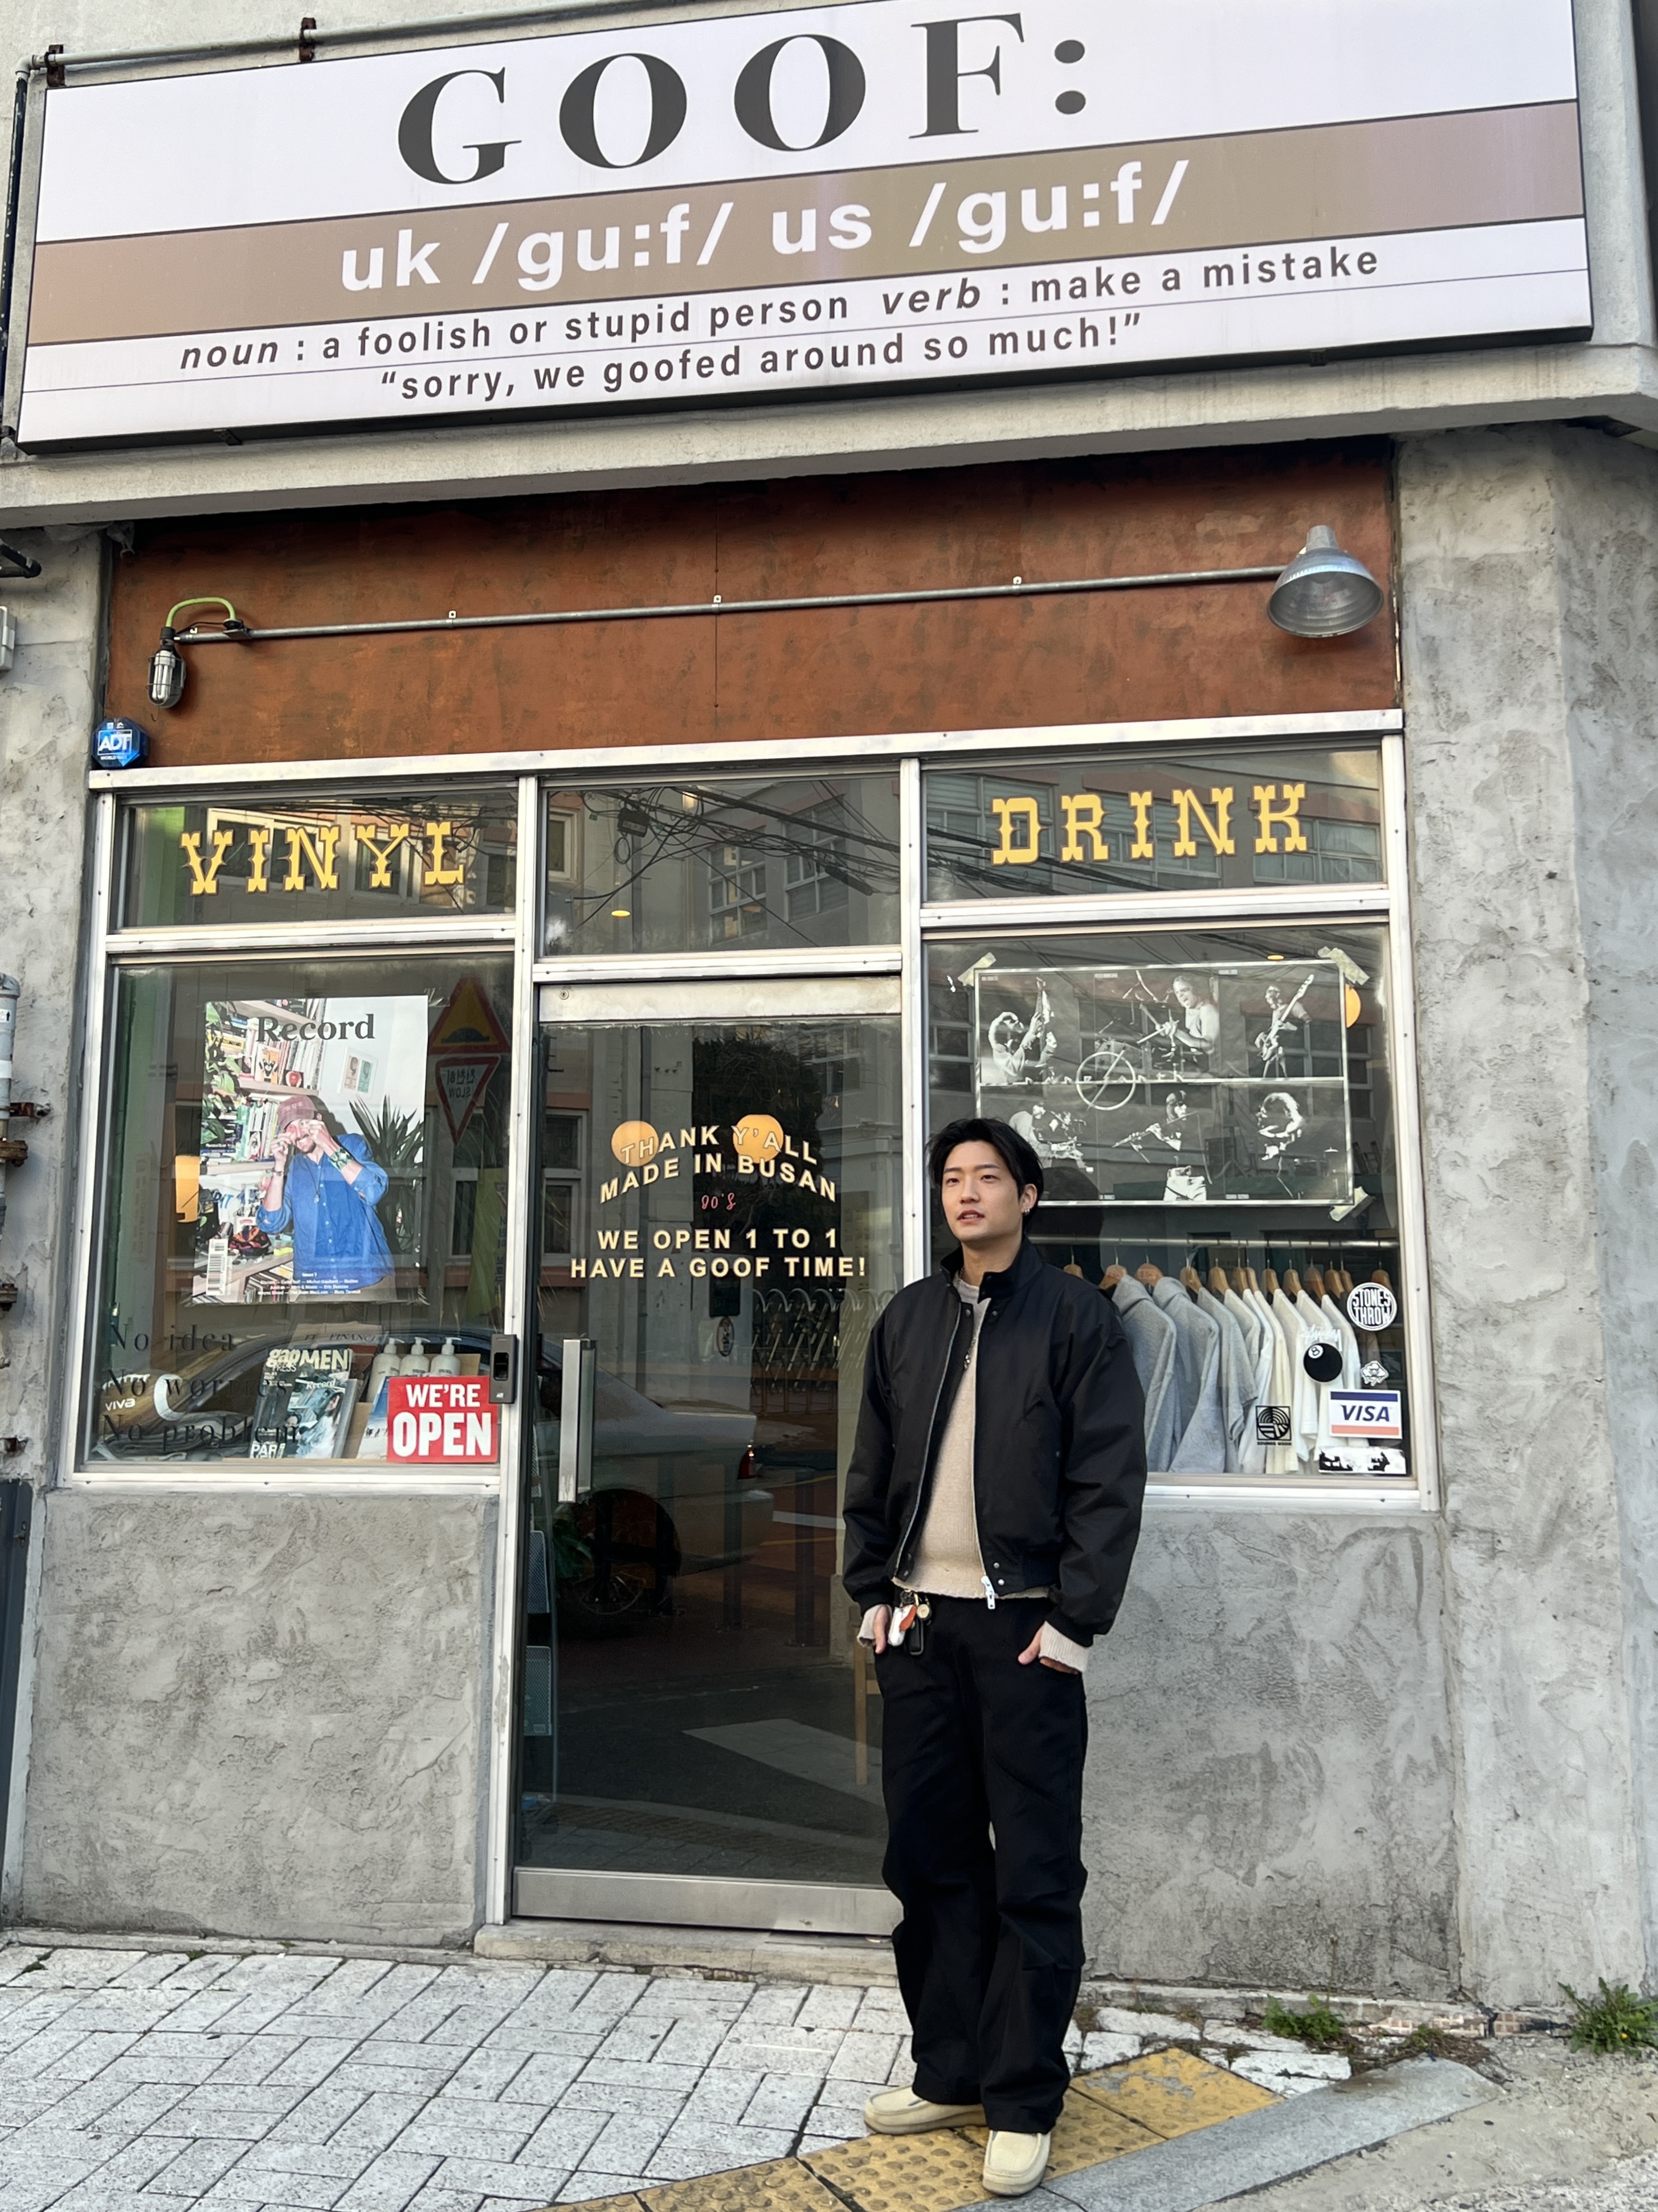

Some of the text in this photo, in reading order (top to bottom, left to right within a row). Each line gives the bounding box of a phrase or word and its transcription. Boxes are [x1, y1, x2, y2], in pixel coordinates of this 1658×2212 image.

[398, 14, 1085, 184] GOOF:
[342, 160, 1189, 292] uk /gu:f/ us /gu:f/
[181, 343, 277, 369] noun
[324, 338, 338, 358] a
[359, 319, 489, 355] foolish
[511, 321, 546, 344] or
[566, 302, 688, 341] stupid
[711, 297, 846, 336] person
[883, 279, 979, 314] verb
[1032, 268, 1140, 301] make
[1163, 269, 1179, 290] a
[1204, 247, 1376, 287] mistake
[534, 366, 583, 389] we
[605, 346, 739, 392] goofed
[761, 333, 901, 373] around
[925, 337, 967, 359] so
[98, 734, 131, 751] ADT
[990, 783, 1308, 866] DRINK
[179, 820, 464, 896] VINYL
[257, 1013, 375, 1042] Record
[621, 1125, 720, 1166] THANK
[600, 1153, 836, 1204] MADE IN BUSAN
[597, 1229, 836, 1250] WE OPEN 1 TO 1
[571, 1257, 865, 1278] HAVE A GOOF TIME!
[1352, 1288, 1391, 1307] STONES
[1353, 1306, 1390, 1325] THROW
[110, 1323, 235, 1351] No idea
[299, 1349, 349, 1370] MEN
[107, 1368, 146, 1397] No
[164, 1377, 287, 1397] worries
[305, 1379, 336, 1389] Record
[1340, 1404, 1390, 1422] VISA
[103, 1414, 299, 1451] No problem
[393, 1412, 492, 1457] OPEN
